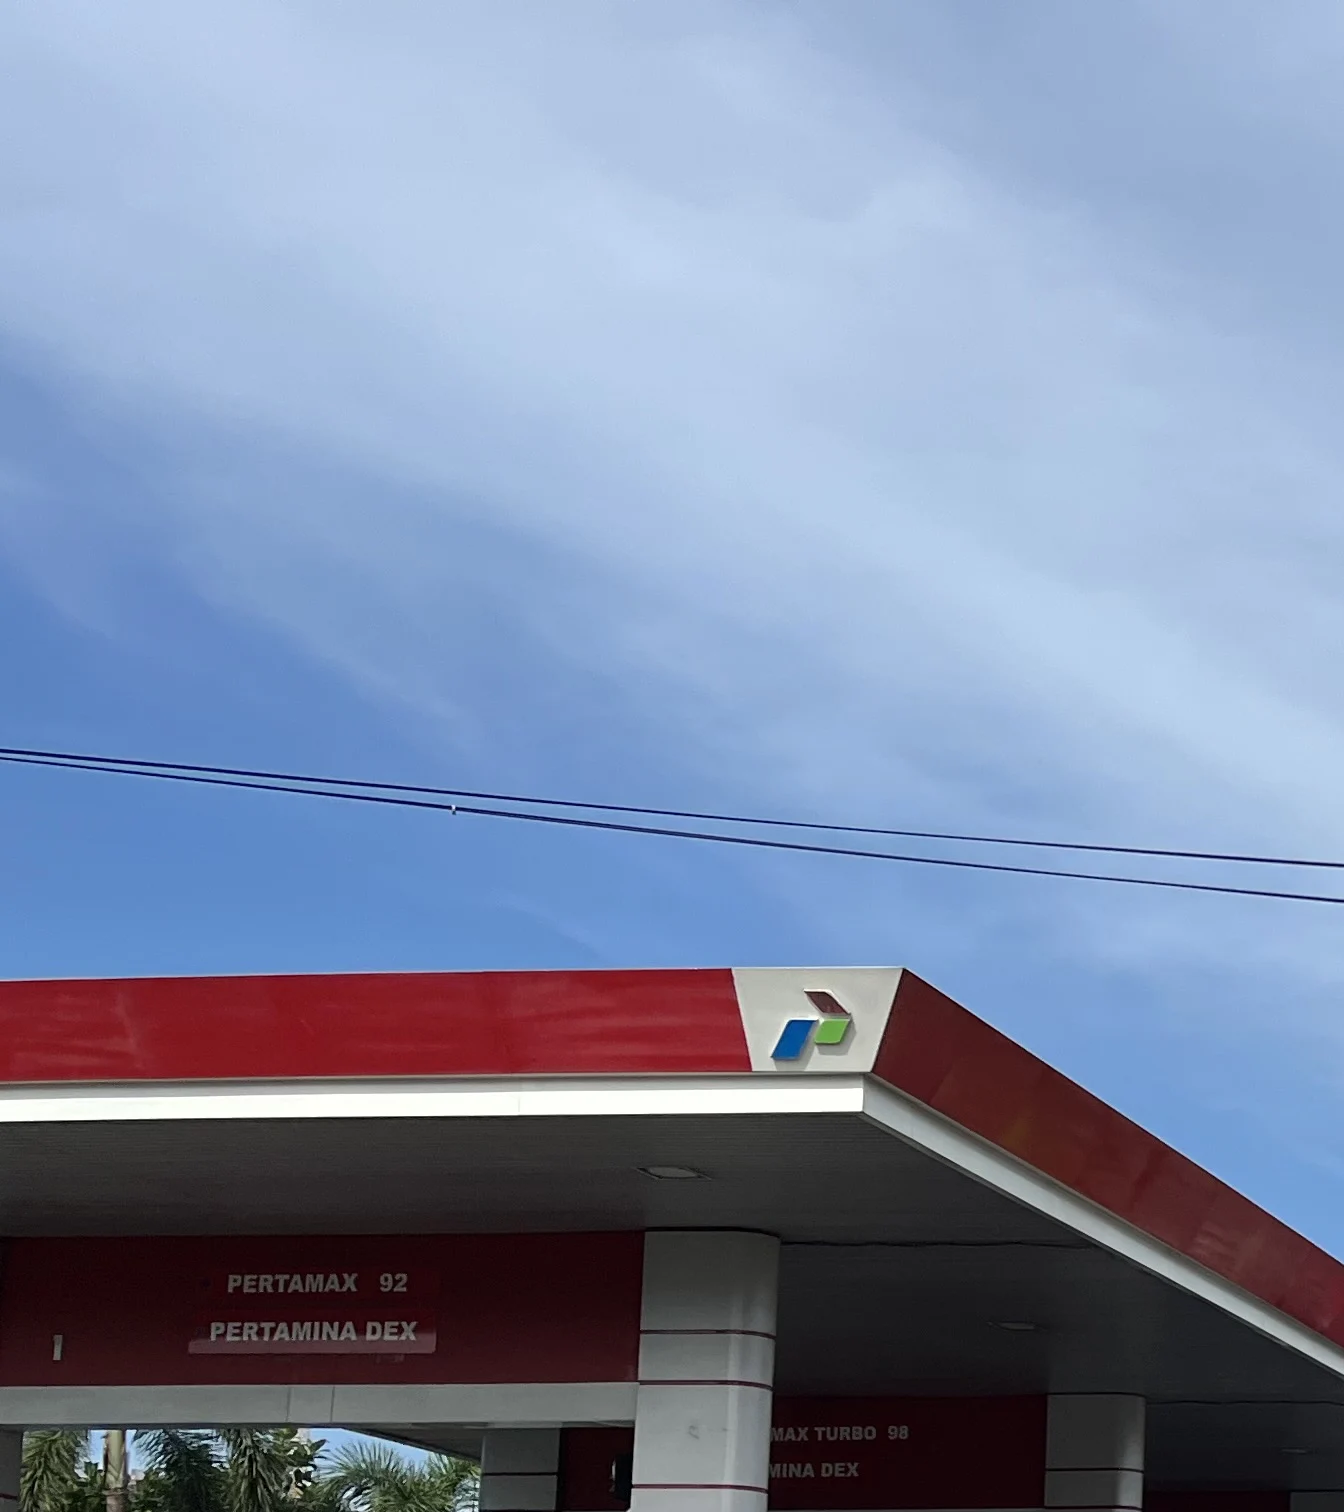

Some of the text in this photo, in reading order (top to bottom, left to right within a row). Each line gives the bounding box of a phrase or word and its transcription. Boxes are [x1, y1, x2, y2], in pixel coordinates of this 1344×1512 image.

[227, 1273, 408, 1293] PERTAMAX 92
[209, 1320, 418, 1342] PERTAMINA DEX
[814, 1425, 877, 1441] TURBO
[887, 1424, 909, 1440] 98
[821, 1462, 860, 1477] DEX
